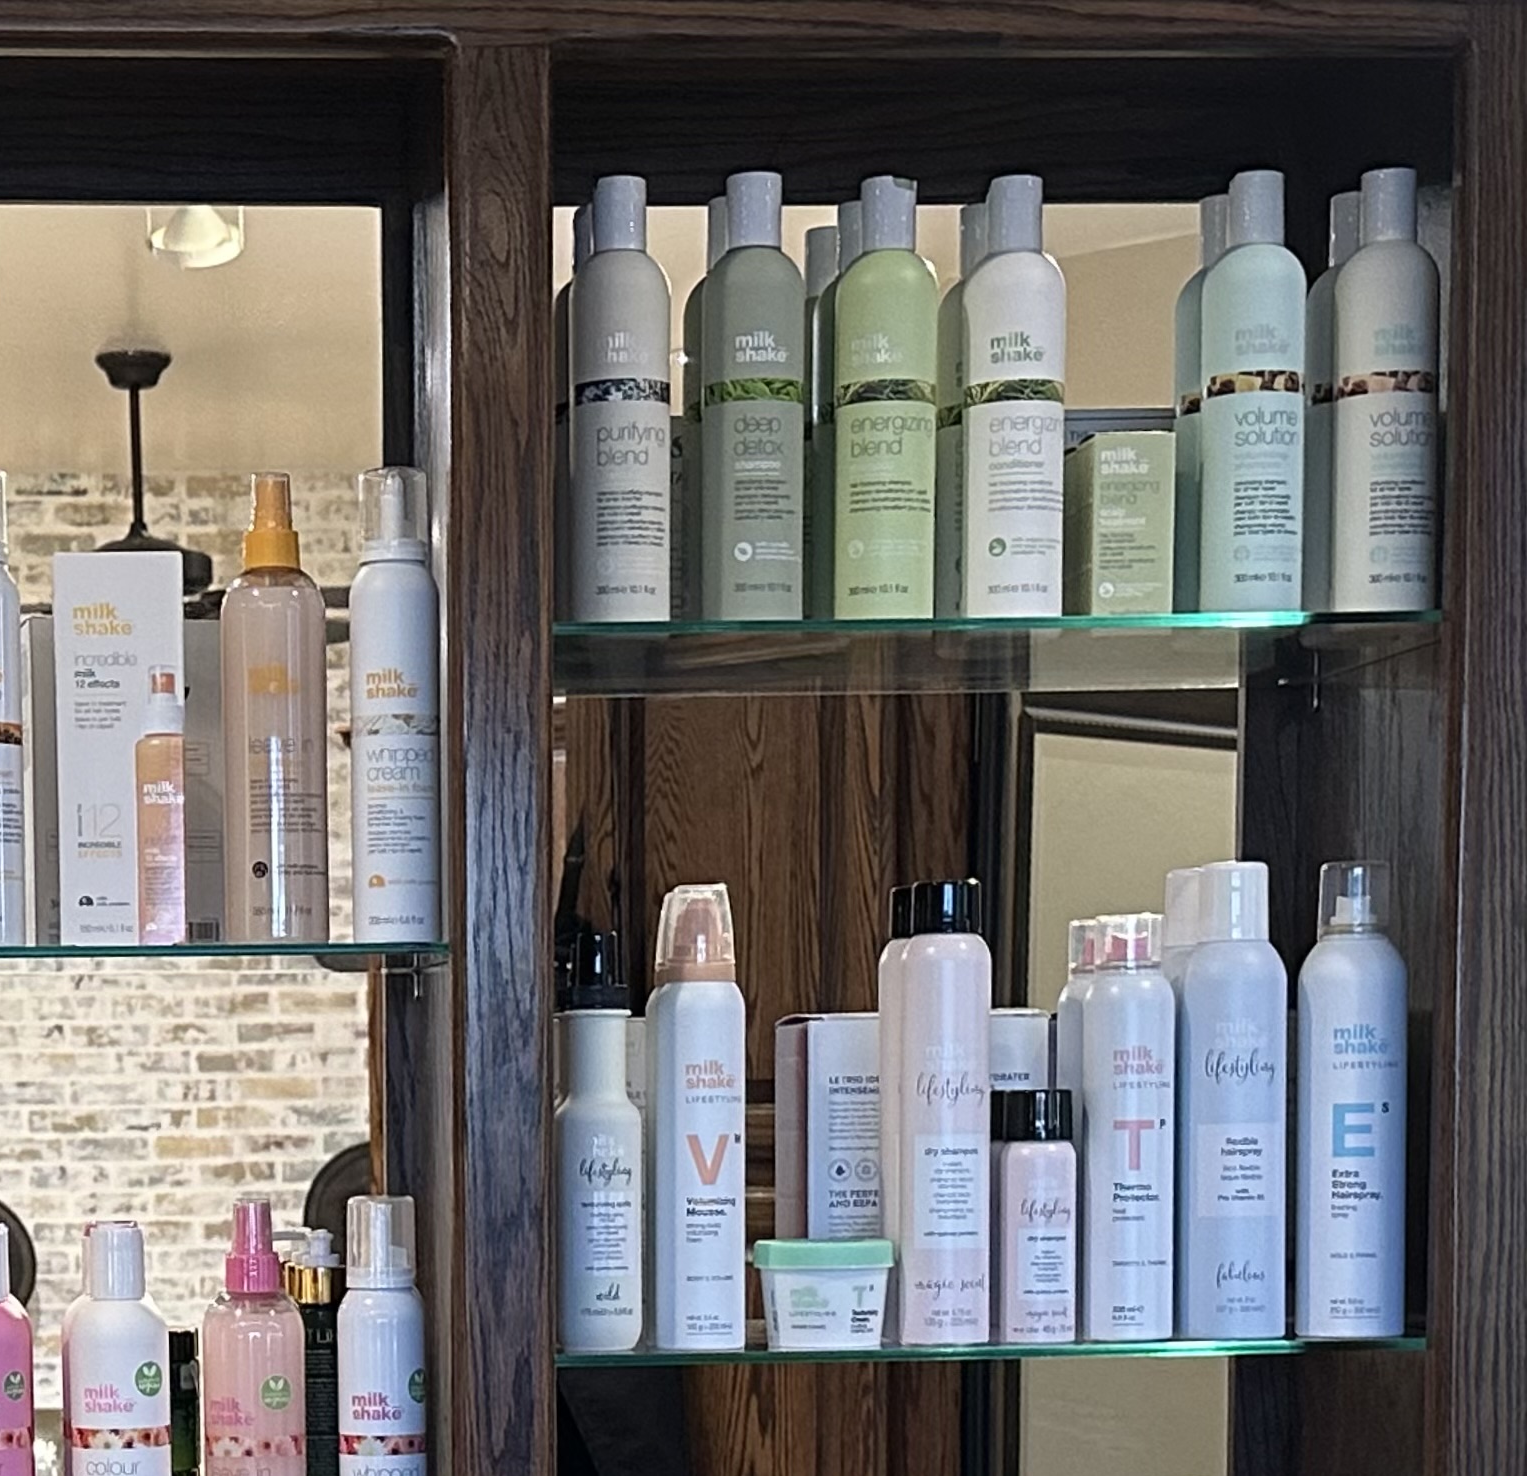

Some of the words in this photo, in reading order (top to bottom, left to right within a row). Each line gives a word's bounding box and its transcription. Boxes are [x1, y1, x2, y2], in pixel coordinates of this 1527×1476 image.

[736, 349, 787, 363] shake
[990, 349, 1044, 364] shake
[1234, 407, 1298, 426] volume
[734, 414, 782, 438] deep
[596, 425, 665, 447] purifying
[1234, 427, 1298, 447] solution
[734, 439, 784, 456] detox
[851, 437, 903, 458] blend
[989, 438, 1042, 458] blend
[596, 448, 648, 466] blend
[74, 603, 116, 618] milk
[74, 619, 132, 635] shake
[75, 653, 137, 666] incredible
[75, 679, 85, 689] 12
[87, 679, 120, 689] effects
[366, 685, 417, 699] shake
[367, 766, 420, 781] cream
[83, 805, 121, 837] 12
[1333, 1042, 1387, 1055] shake
[1113, 1061, 1163, 1075] shake
[1205, 1049, 1275, 1086] lifestyling
[686, 1076, 730, 1089] shake
[917, 1072, 985, 1106] lifestyling
[1332, 1102, 1375, 1158] E
[1113, 1119, 1154, 1170] T
[686, 1134, 729, 1185] V
[1331, 1169, 1359, 1178] Extra
[1113, 1183, 1152, 1191] Thermo
[1331, 1179, 1367, 1190] Strong
[1216, 1260, 1265, 1289] fabulous
[85, 1400, 134, 1413] shake
[353, 1408, 401, 1421] shake
[86, 1459, 141, 1476] colour
